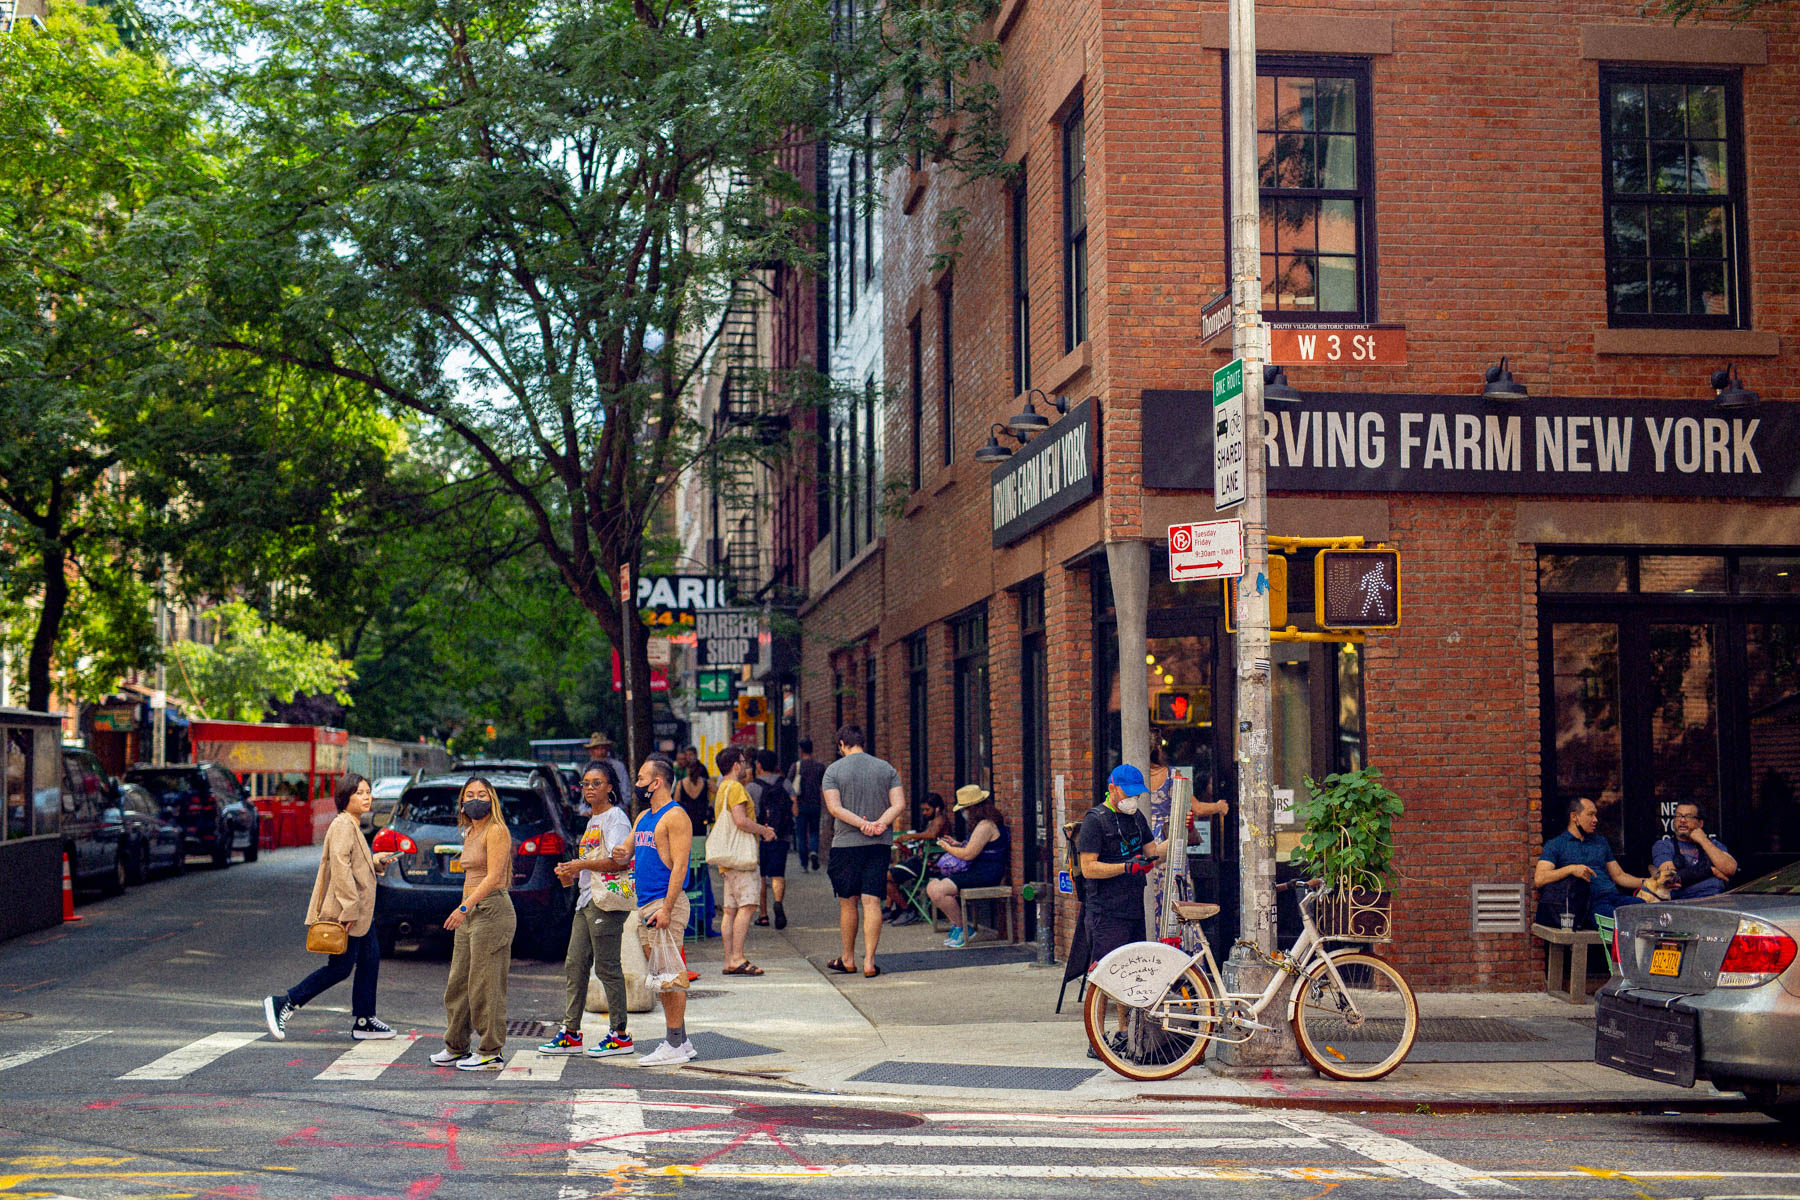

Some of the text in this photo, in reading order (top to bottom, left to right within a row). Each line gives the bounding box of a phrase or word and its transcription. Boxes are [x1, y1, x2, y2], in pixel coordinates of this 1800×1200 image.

[1202, 304, 1231, 338] Thompson
[1297, 334, 1377, 361] W 3 St
[1215, 369, 1241, 397] BIKE ROUTE
[1263, 411, 1762, 474] RVING FARM NEW YORK
[1216, 441, 1242, 470] SHARED
[993, 421, 1088, 531] IRVING FARM NEW YORK
[1221, 470, 1239, 496] LANE
[1194, 530, 1217, 539] Tuesday
[1194, 539, 1212, 547] Friday
[1195, 550, 1216, 558] 9:30am
[1221, 548, 1233, 556] 11am
[696, 613, 758, 639] BARBER
[706, 639, 749, 664] SHOP
[1660, 801, 1678, 816] NE
[1109, 955, 1162, 975] Cocktails
[1120, 967, 1159, 979] Comedy
[1123, 985, 1157, 997] Jazz
